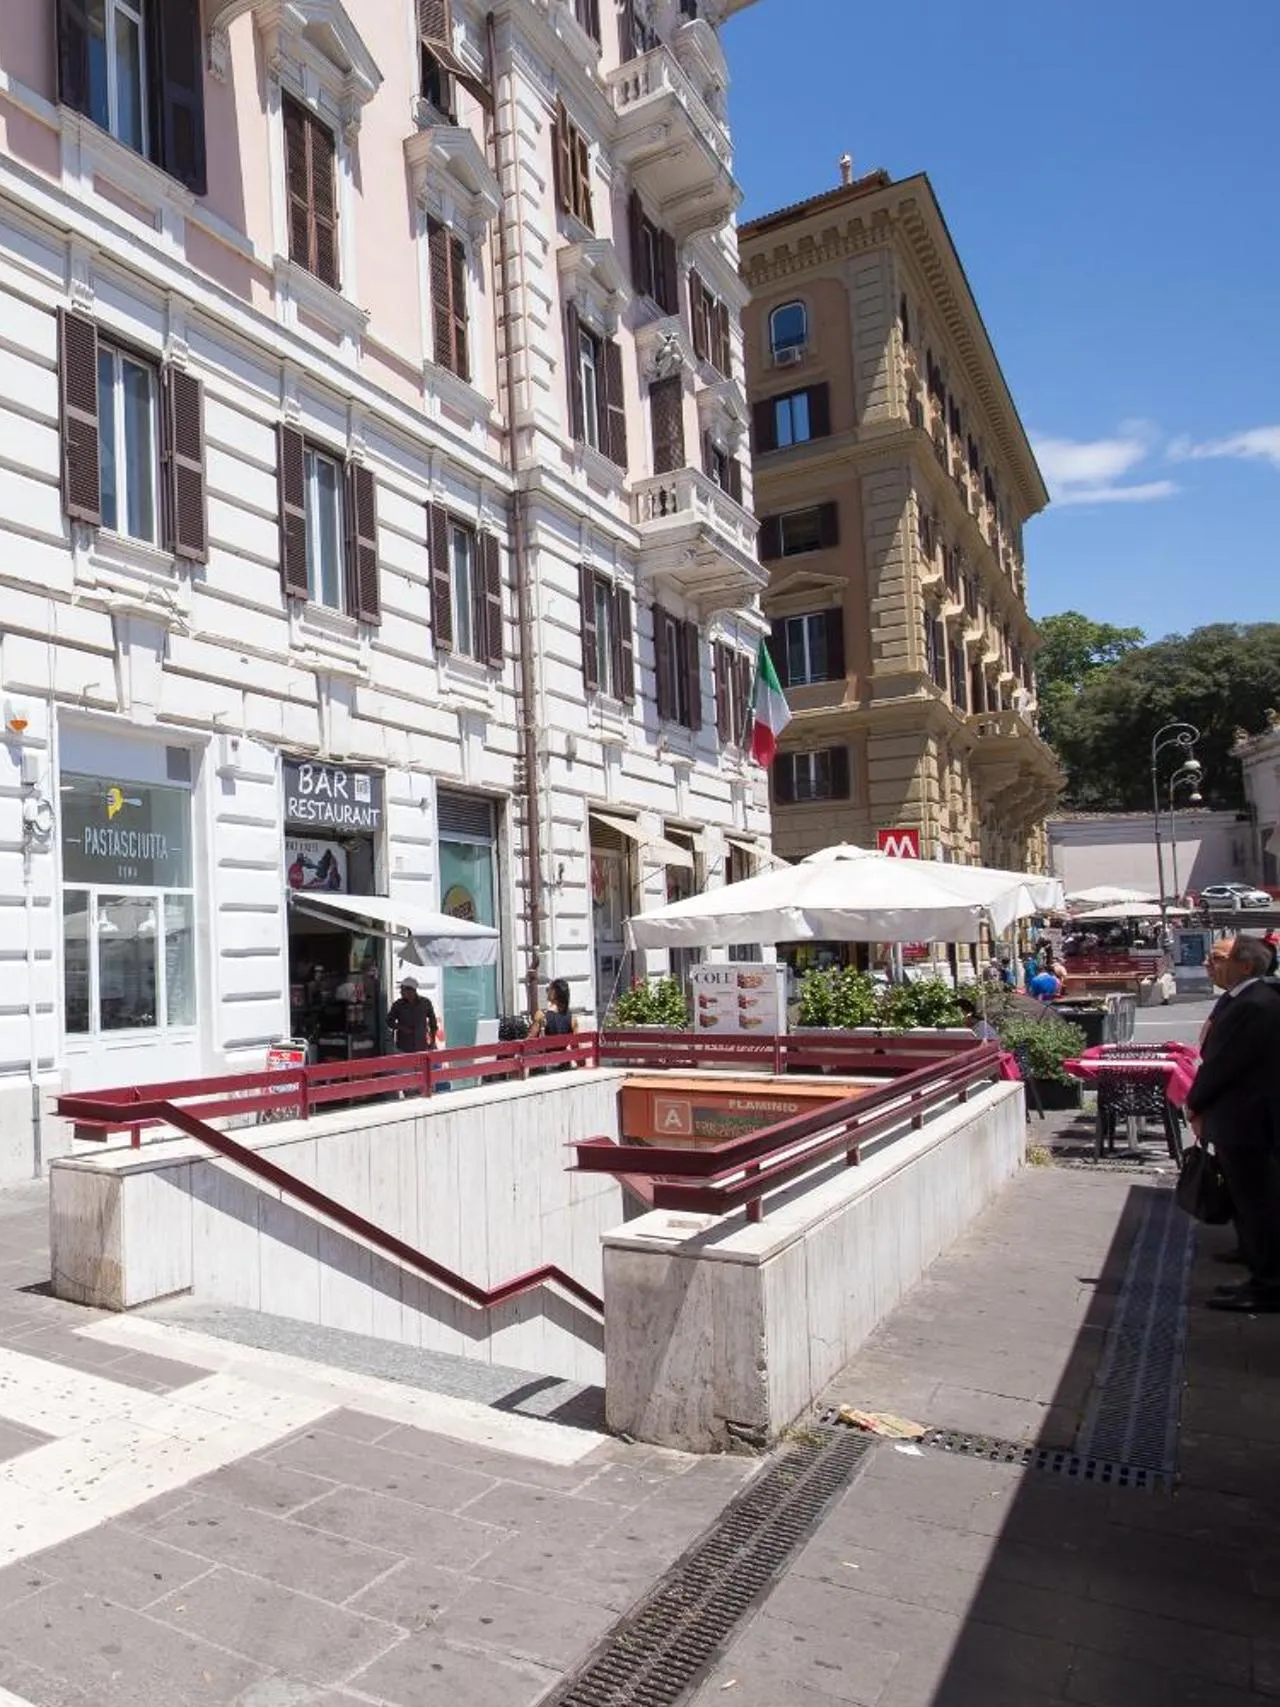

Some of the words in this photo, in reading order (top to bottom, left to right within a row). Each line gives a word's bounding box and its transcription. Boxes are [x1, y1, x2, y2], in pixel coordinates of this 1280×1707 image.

[298, 763, 349, 799] BAR
[287, 797, 381, 827] RESTAURANT
[84, 826, 168, 860] PASTASCIUTTA
[663, 1108, 683, 1128] A
[727, 1098, 799, 1114] FLAMINIO
